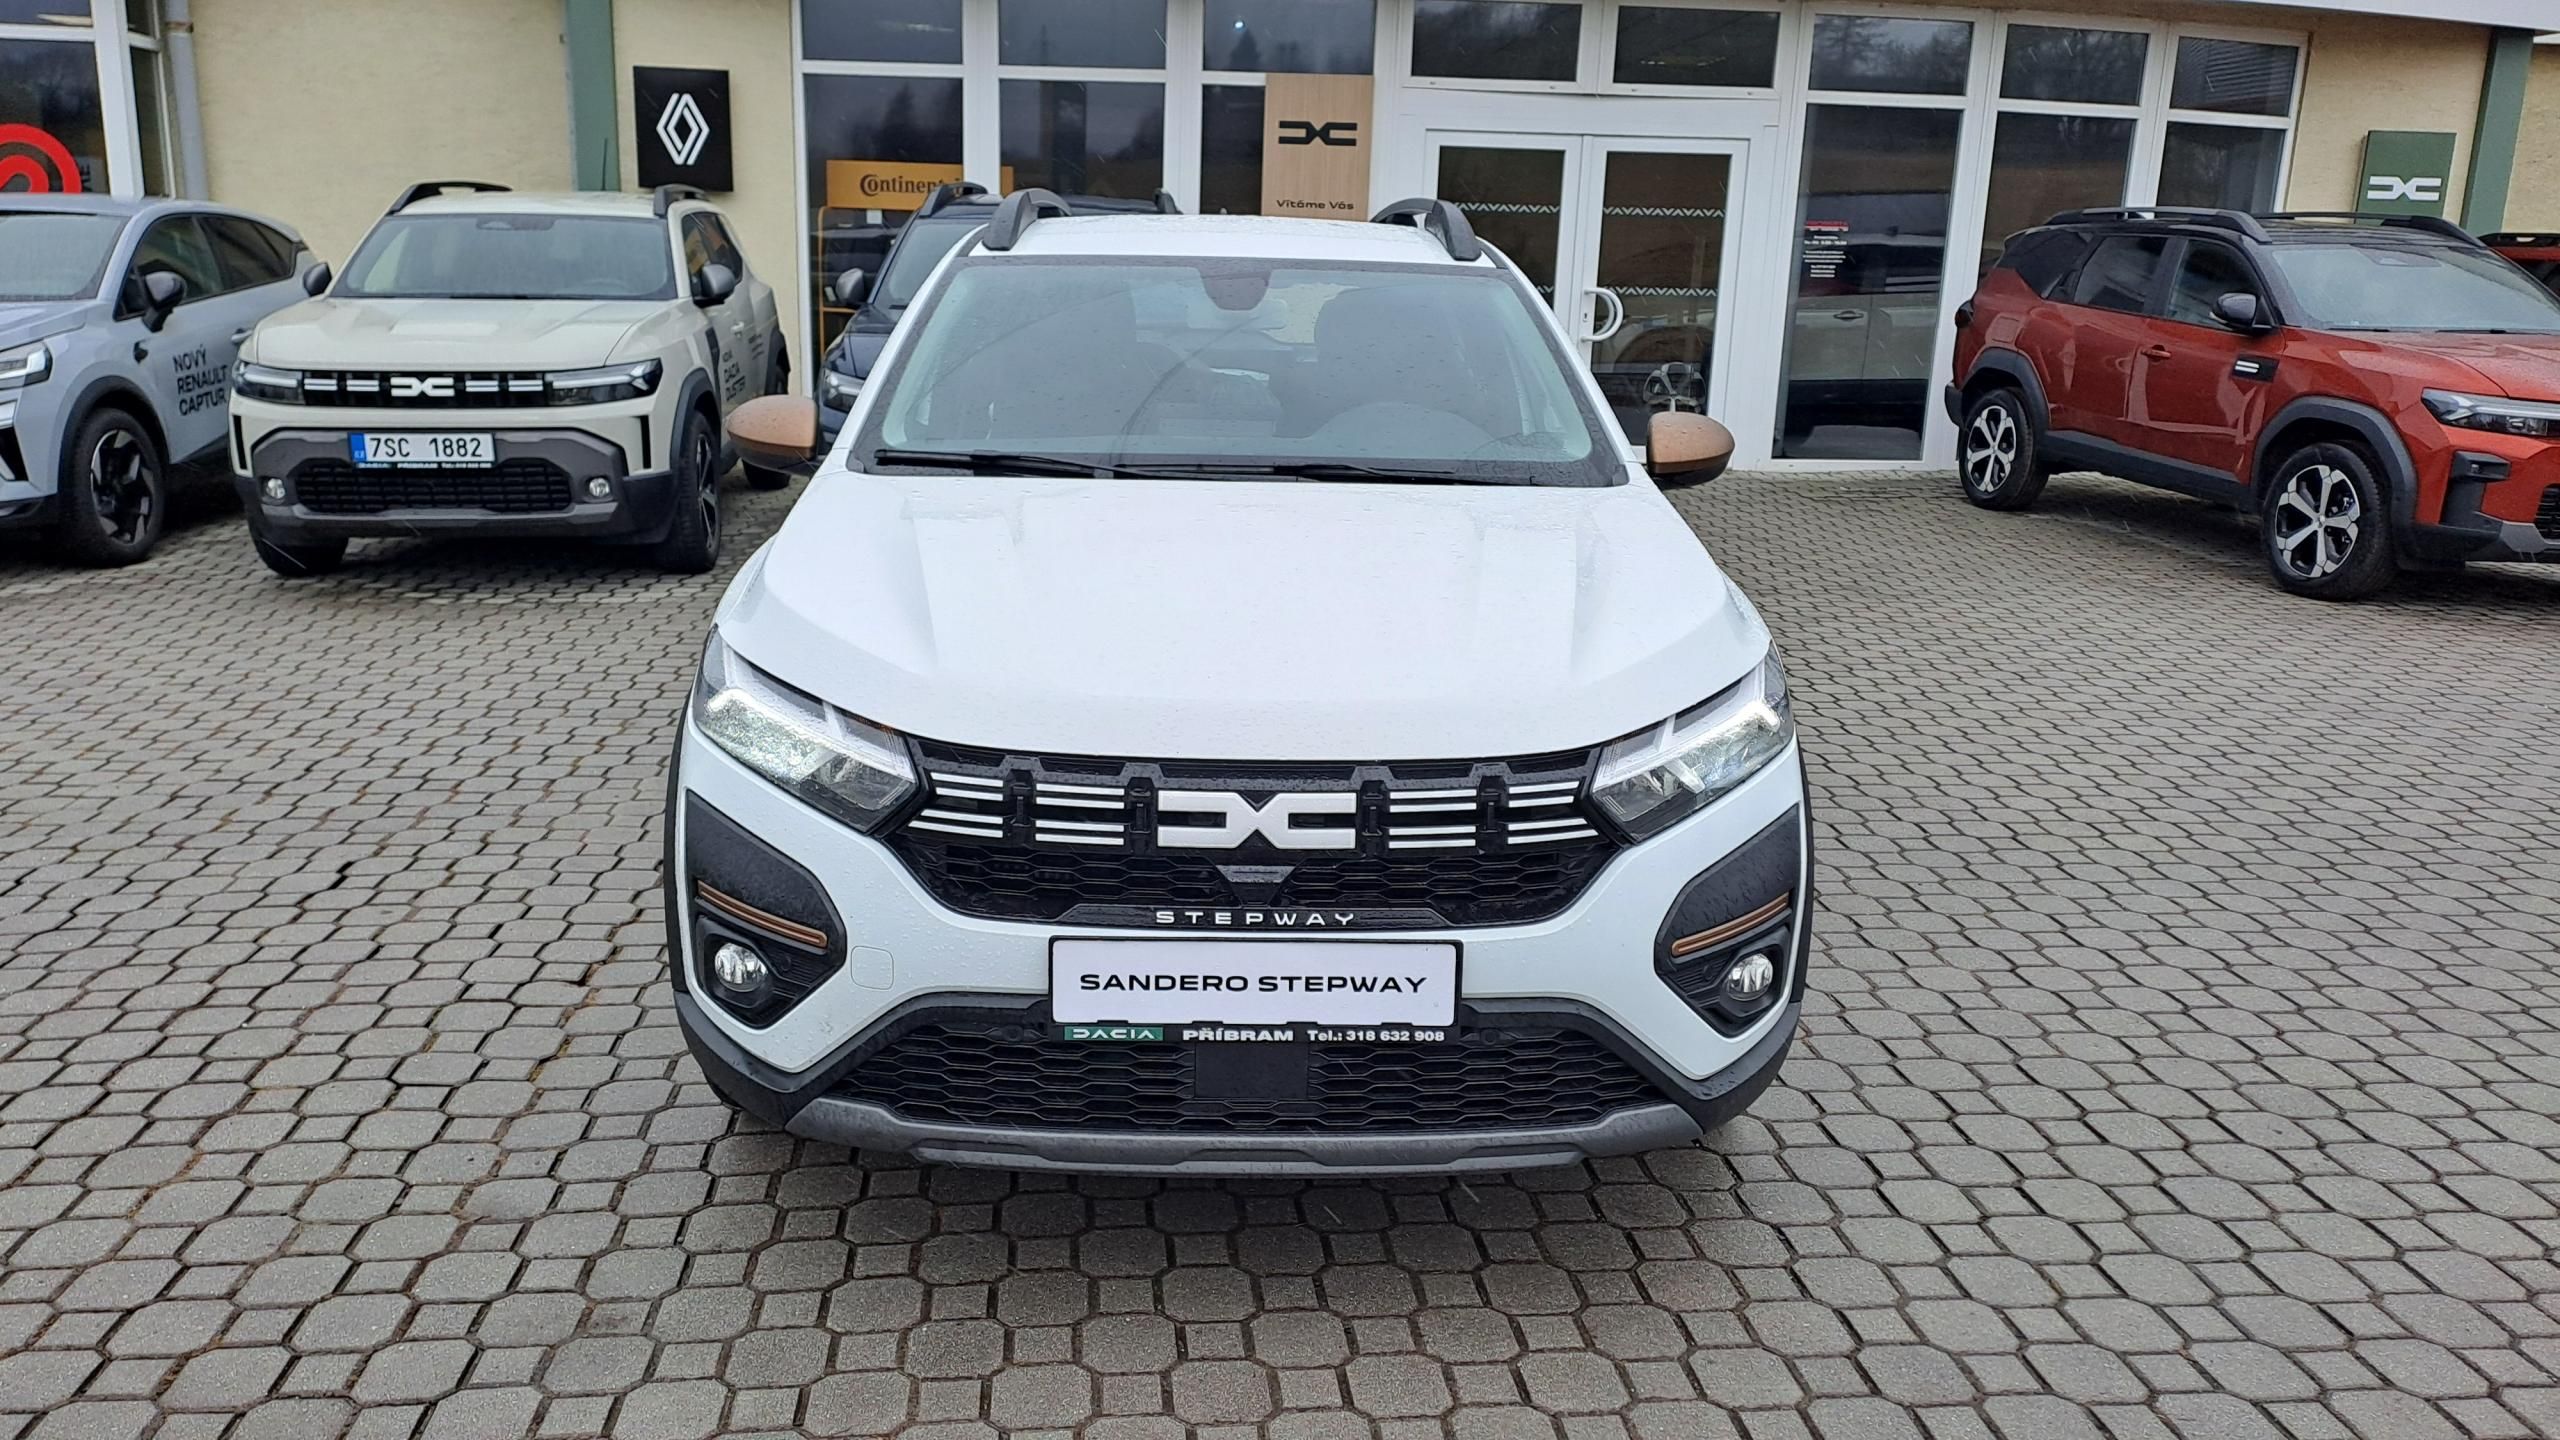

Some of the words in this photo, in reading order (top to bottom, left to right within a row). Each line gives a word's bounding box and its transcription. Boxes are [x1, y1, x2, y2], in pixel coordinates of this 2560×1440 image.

[1329, 200, 1355, 210] Vás
[173, 344, 206, 373] NOVÝ
[177, 364, 228, 394] RENAULT
[179, 387, 227, 416] CAPTUR
[369, 437, 411, 458] 7SC
[429, 437, 482, 458] 1882
[1156, 911, 1354, 926] STEPWAY
[1080, 973, 1249, 992] SANDERO
[1258, 975, 1427, 993] STEPWAY
[1072, 1028, 1155, 1040] DACIA
[1182, 1027, 1294, 1042] PŘÍBRAM
[1306, 1030, 1343, 1042] Tel.:
[1346, 1030, 1376, 1042] 318
[1379, 1031, 1410, 1042] 632
[1414, 1031, 1445, 1042] 908
